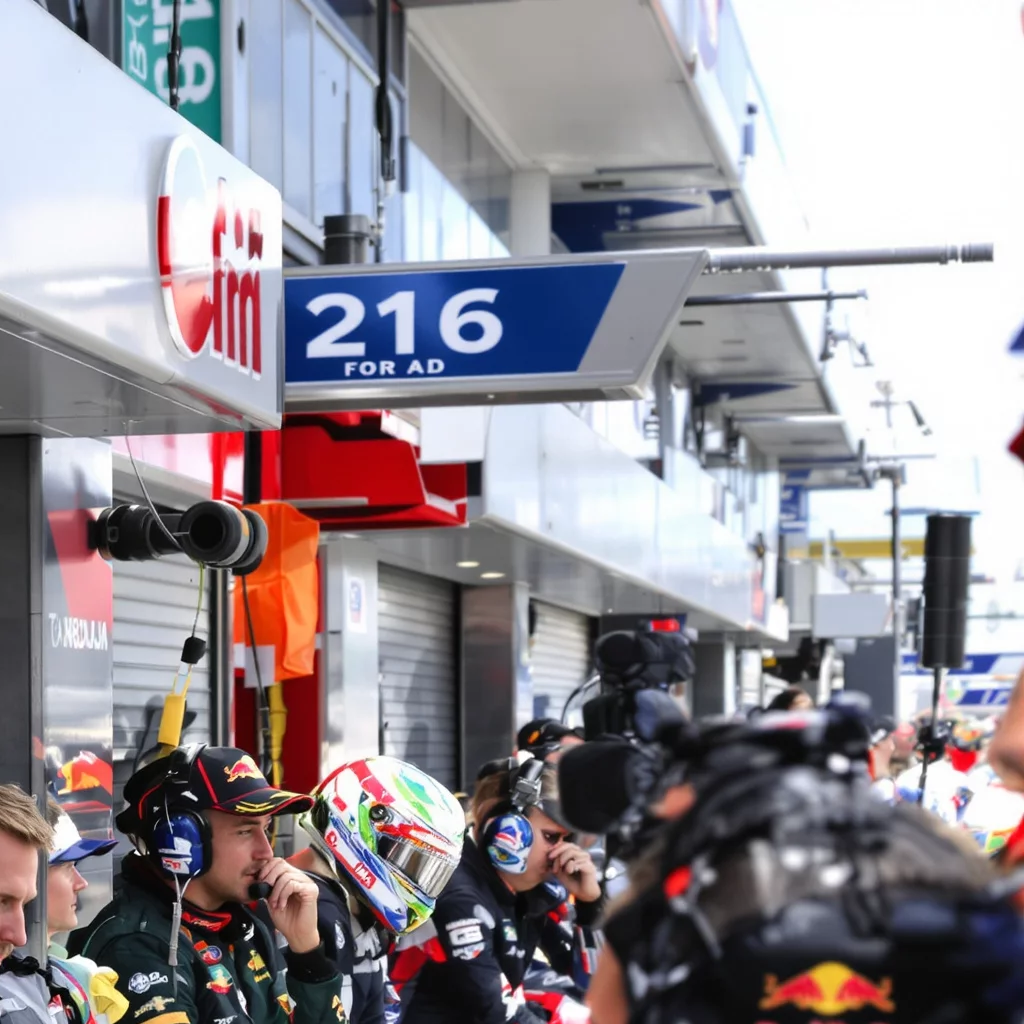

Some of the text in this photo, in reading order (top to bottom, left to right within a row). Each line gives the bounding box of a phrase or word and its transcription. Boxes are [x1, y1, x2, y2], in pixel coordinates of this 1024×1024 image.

[306, 287, 503, 358] 216
[344, 358, 445, 377] FOR AD
